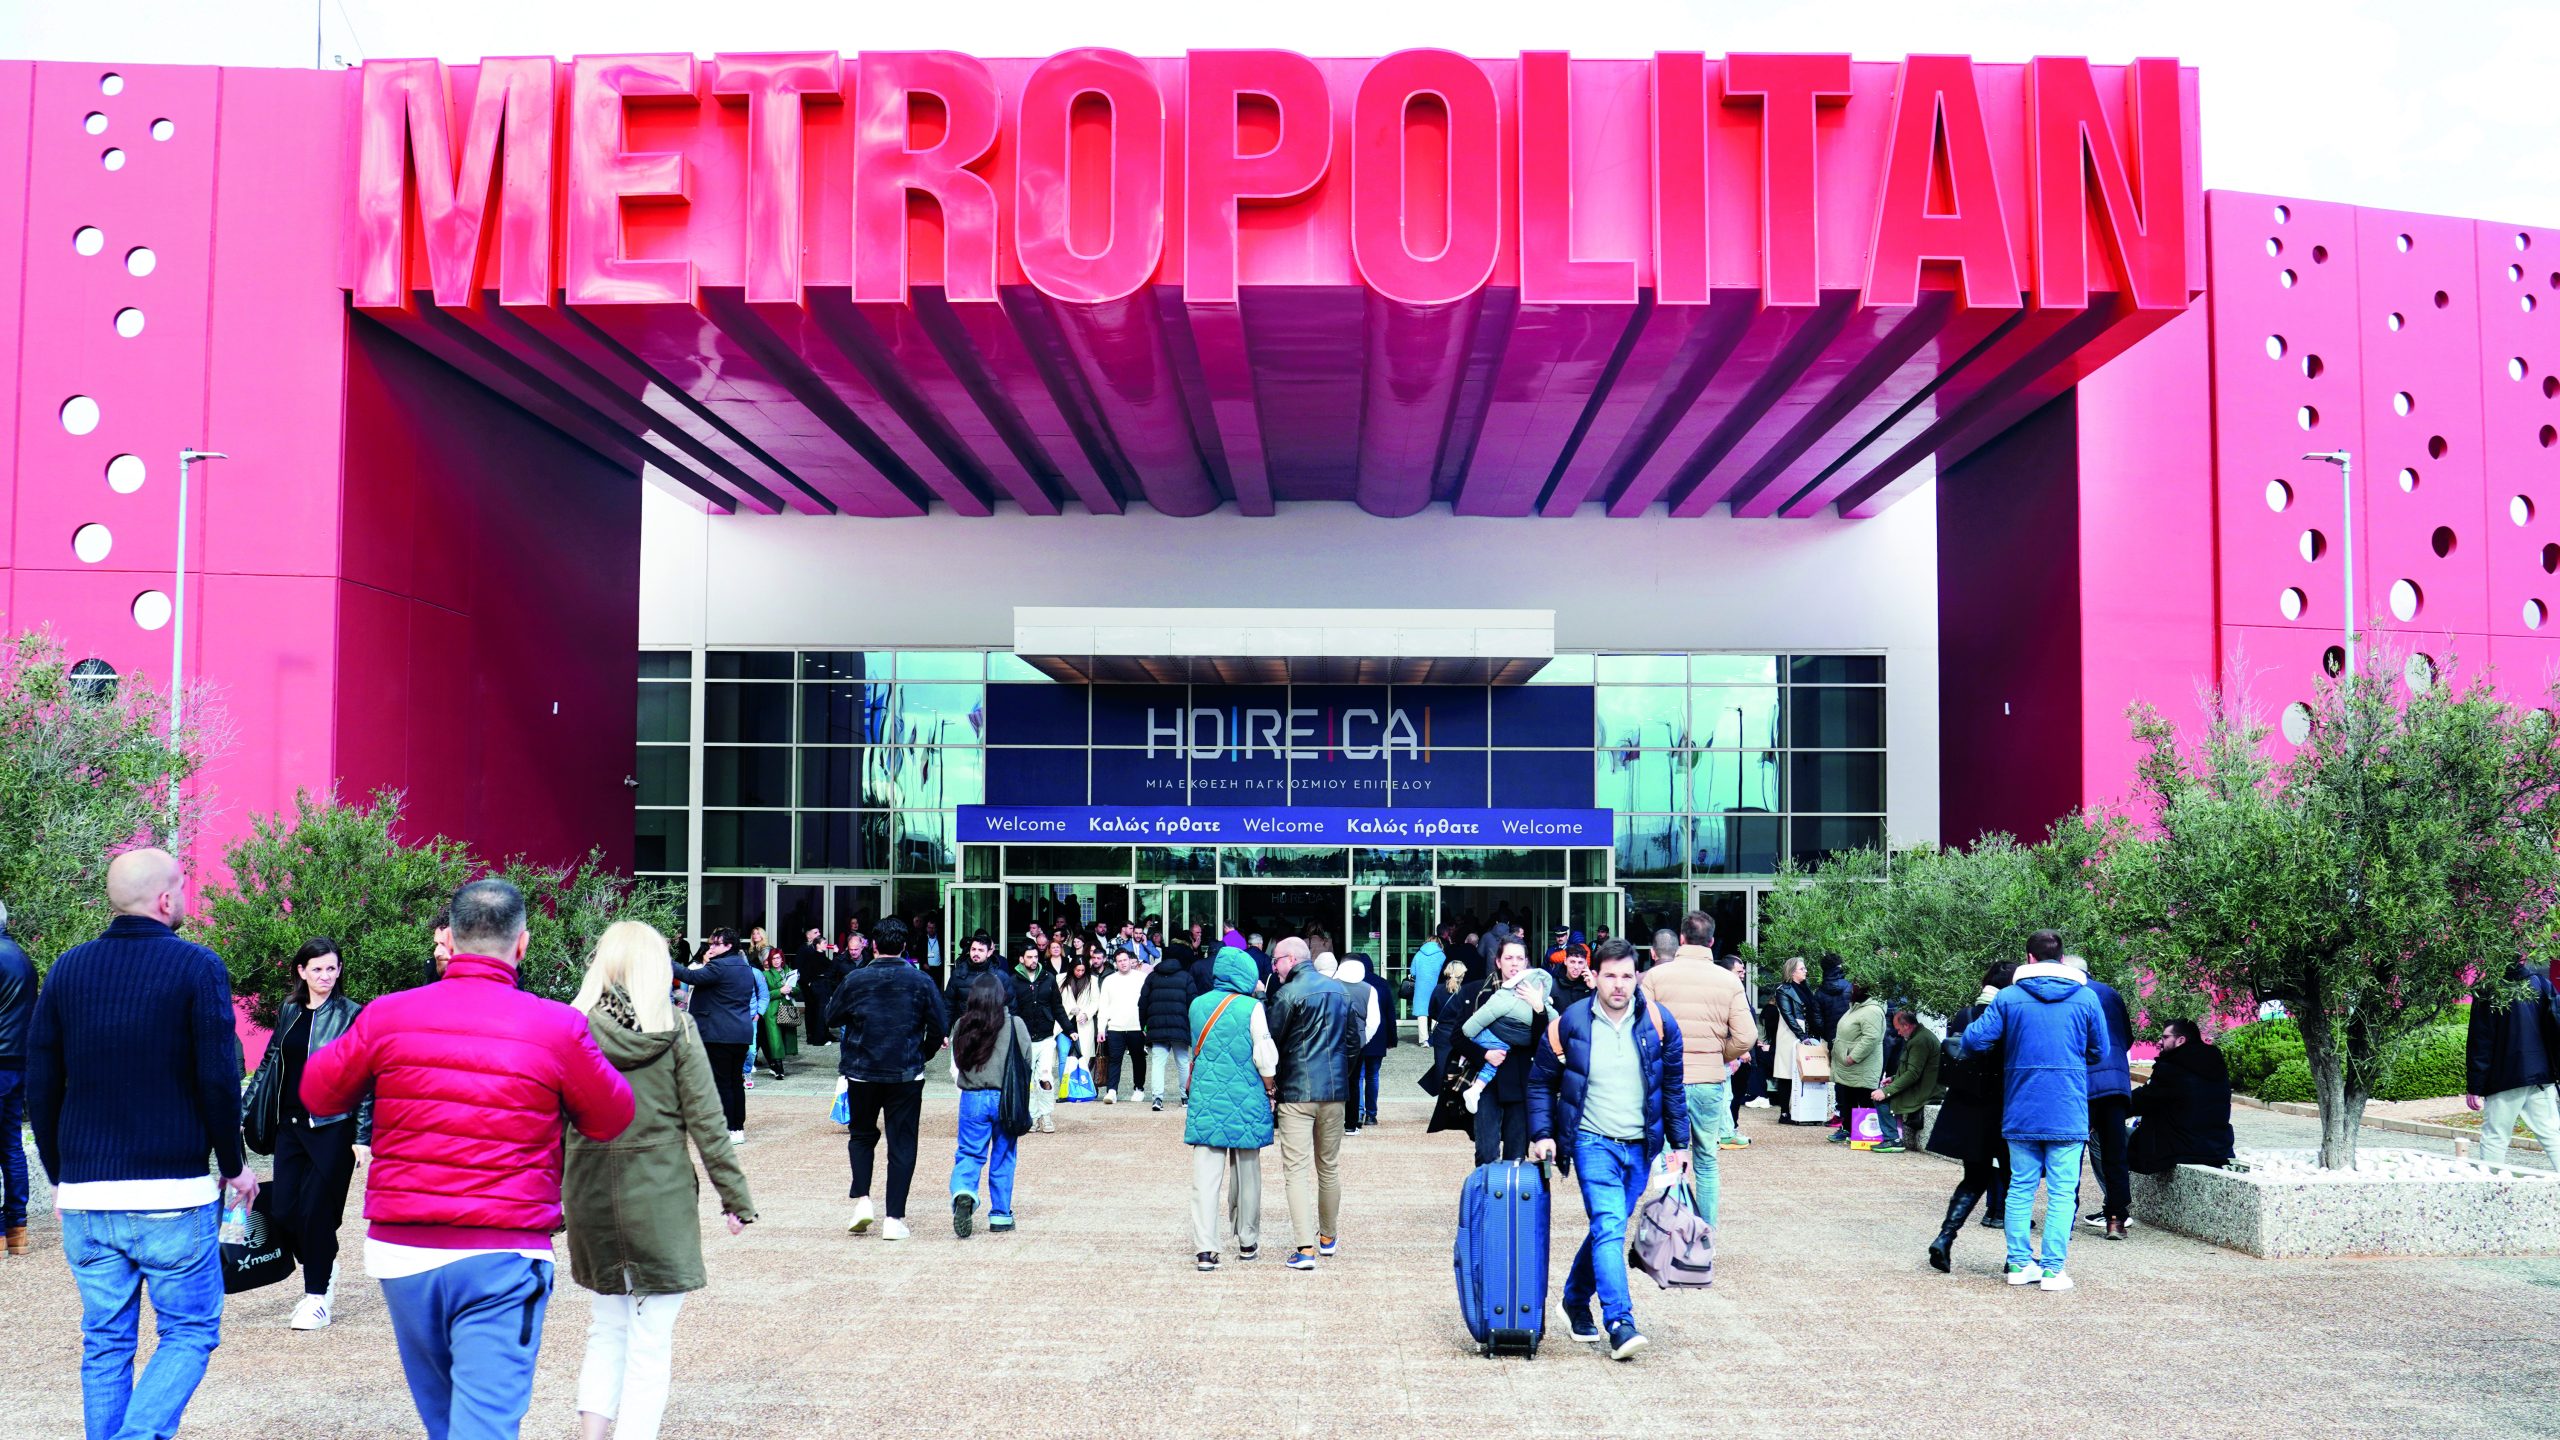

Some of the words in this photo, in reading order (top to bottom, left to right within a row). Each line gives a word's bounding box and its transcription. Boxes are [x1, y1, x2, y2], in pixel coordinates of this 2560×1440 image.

[352, 46, 2190, 311] METROPOLITAN
[1146, 779, 1173, 789] ΜΙΑ
[1178, 779, 1238, 789] ΕΚΘΕΣΗ
[1354, 779, 1432, 790] ΕΠΙΠΕΔΟΥ
[986, 816, 1066, 831] Welcome
[1089, 816, 1150, 833] Καλώς
[1155, 816, 1221, 835] ήρθατε
[1243, 817, 1324, 833] Welcome
[1347, 818, 1408, 835] Καλώς
[1414, 818, 1480, 837] ήρθατε
[1502, 819, 1583, 834] Welcome
[251, 1248, 282, 1265] mexil
